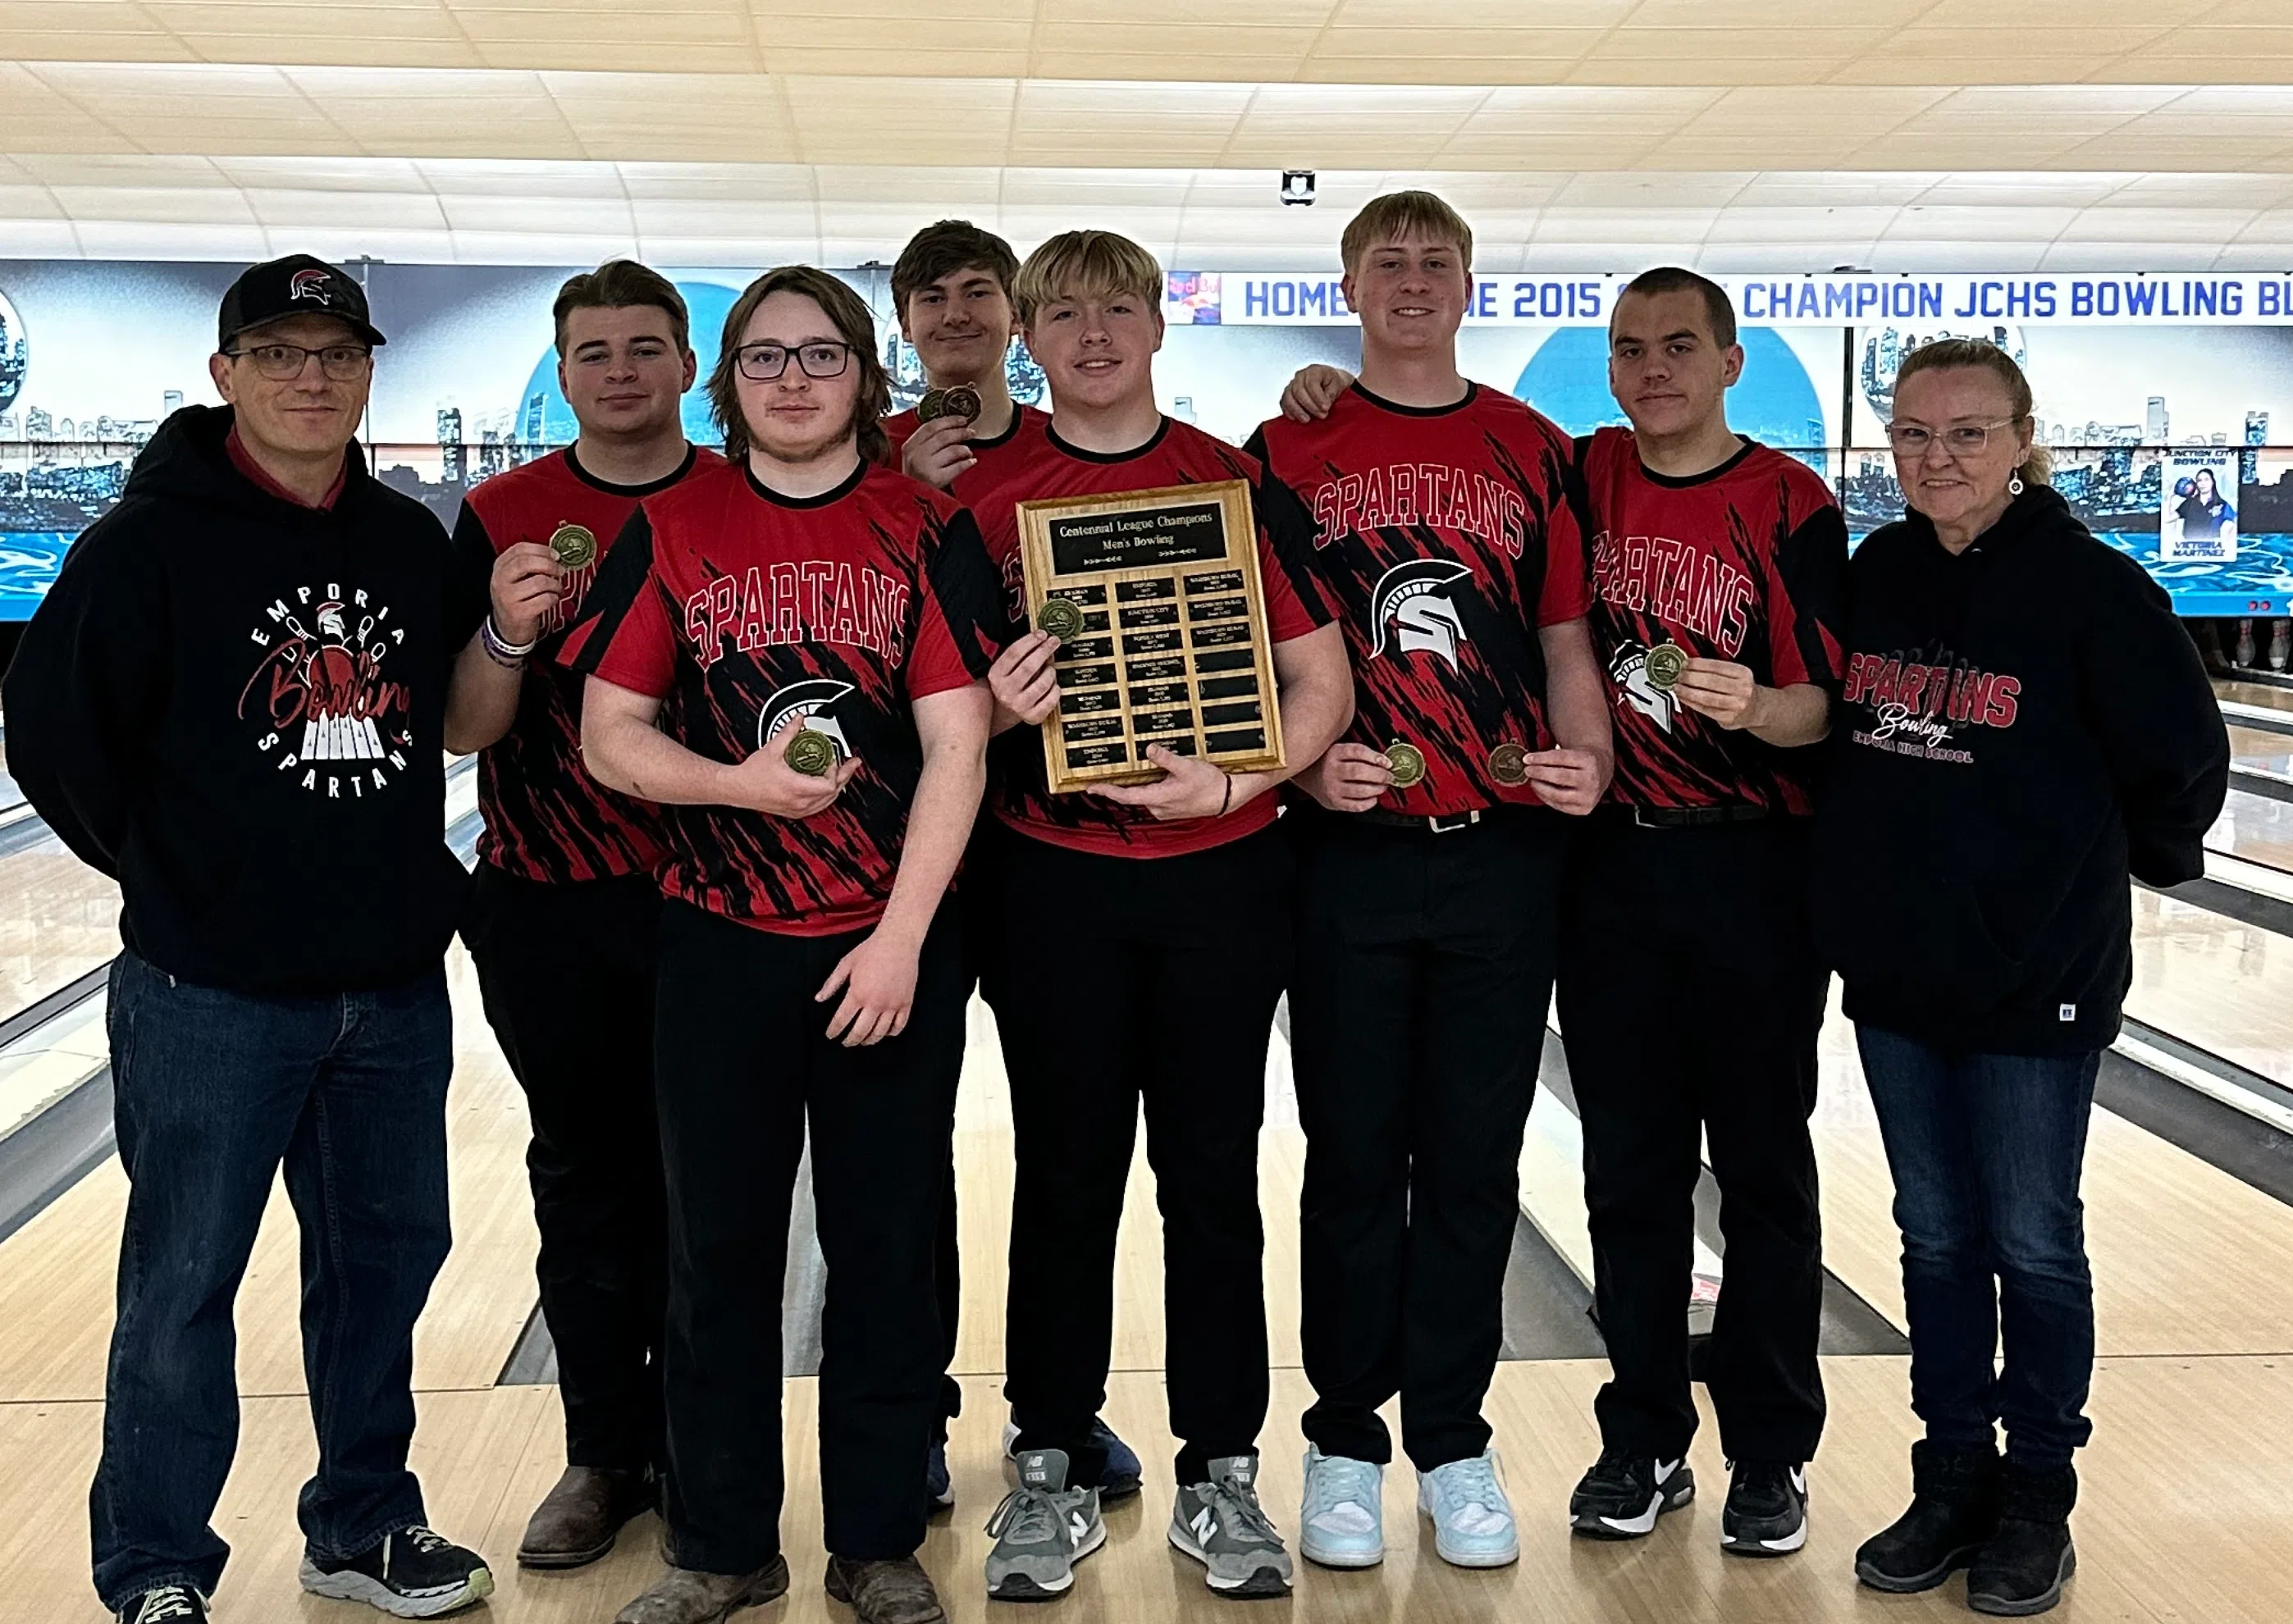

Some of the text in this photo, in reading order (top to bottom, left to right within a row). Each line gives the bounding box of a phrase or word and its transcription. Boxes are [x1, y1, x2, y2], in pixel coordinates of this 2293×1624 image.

[1245, 282, 1348, 317] HOME
[1514, 283, 1601, 318] 2015
[1744, 282, 1943, 318] CHAMPION
[1955, 282, 2056, 317] JCHS
[2071, 281, 2242, 317] BOWLING
[1059, 513, 1213, 537] Centennial League Champions
[1313, 463, 1524, 559] SPARTANS
[1102, 534, 1175, 551] Men's Bowling
[251, 583, 404, 645] EMPORIA
[685, 560, 911, 673] SPARTANS
[1871, 702, 1954, 748] Bowling
[258, 730, 413, 799] SPARTANS
[1925, 747, 1974, 764] SCHOOL
